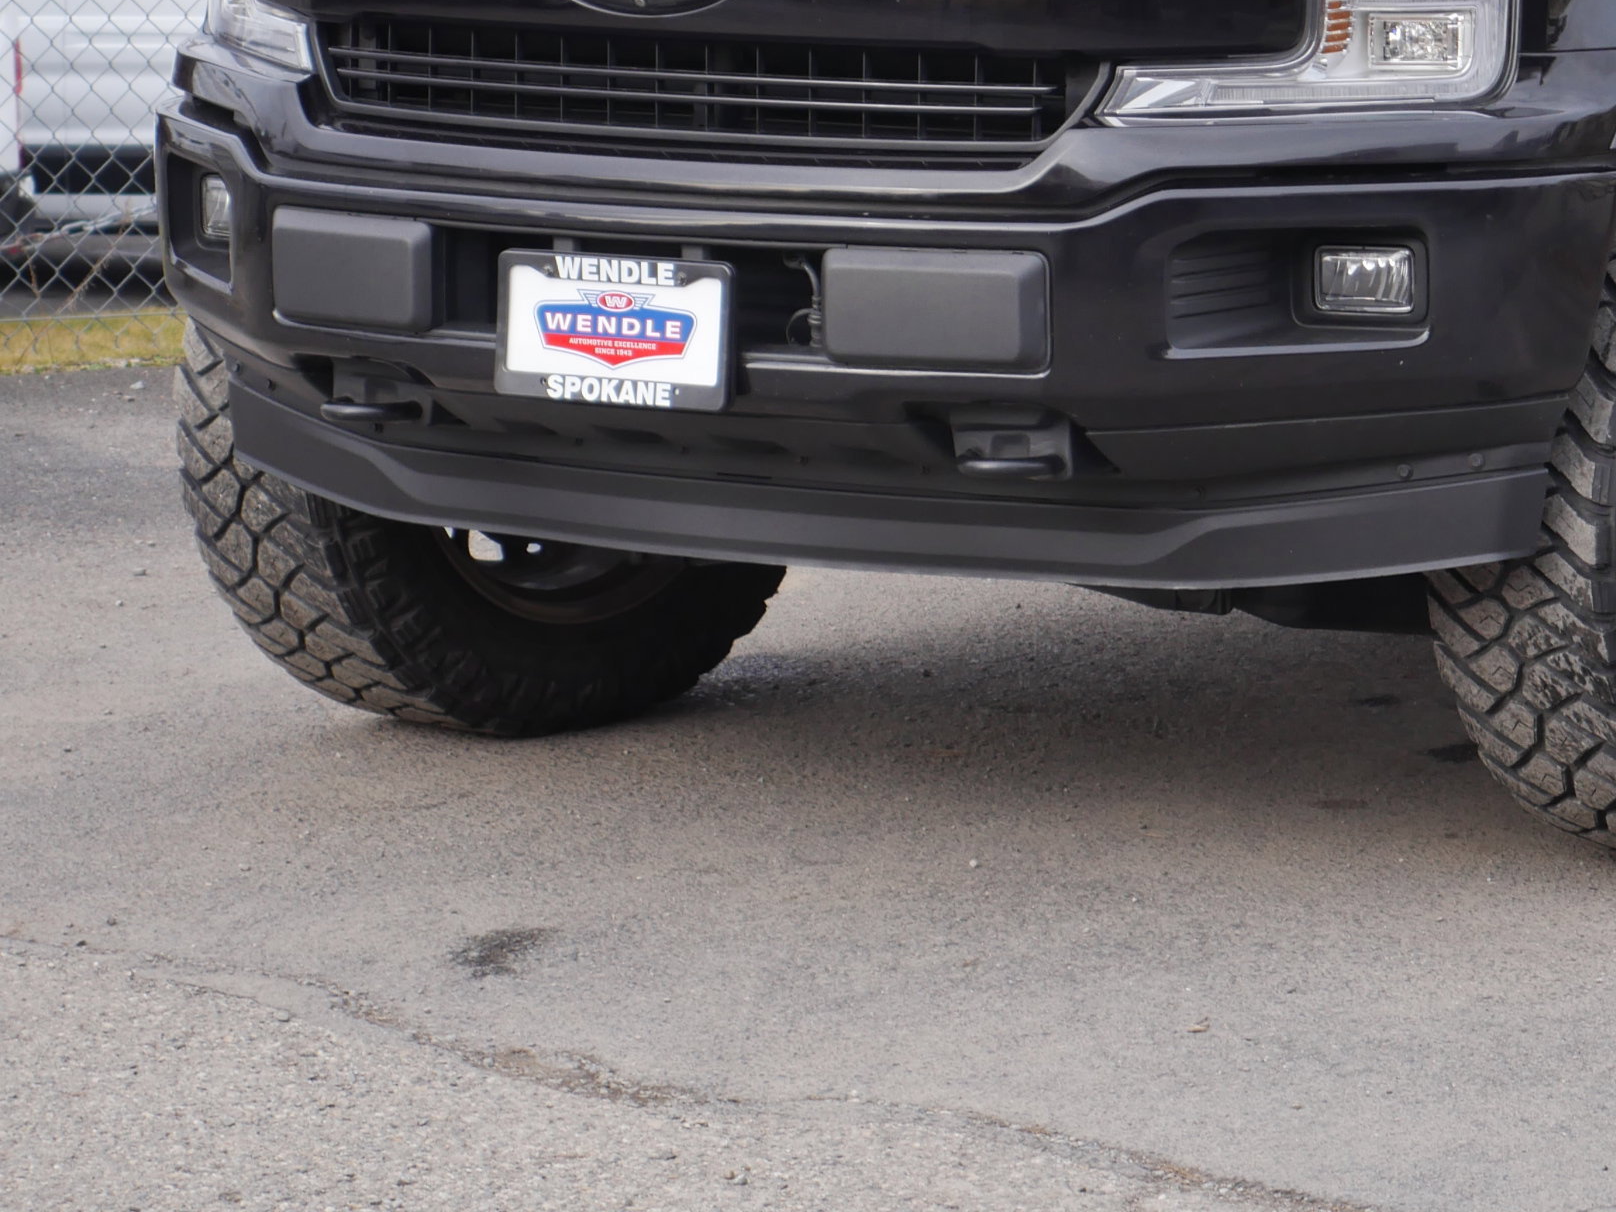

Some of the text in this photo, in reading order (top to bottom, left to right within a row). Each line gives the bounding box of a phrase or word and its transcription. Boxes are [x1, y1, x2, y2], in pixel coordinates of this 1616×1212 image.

[555, 255, 675, 286] WENDLE
[545, 312, 681, 339] WENDLE
[569, 337, 656, 350] AUTOMOTIVE EXCELLENCE
[595, 348, 615, 356] SINCE
[547, 375, 671, 407] SPOKANE
